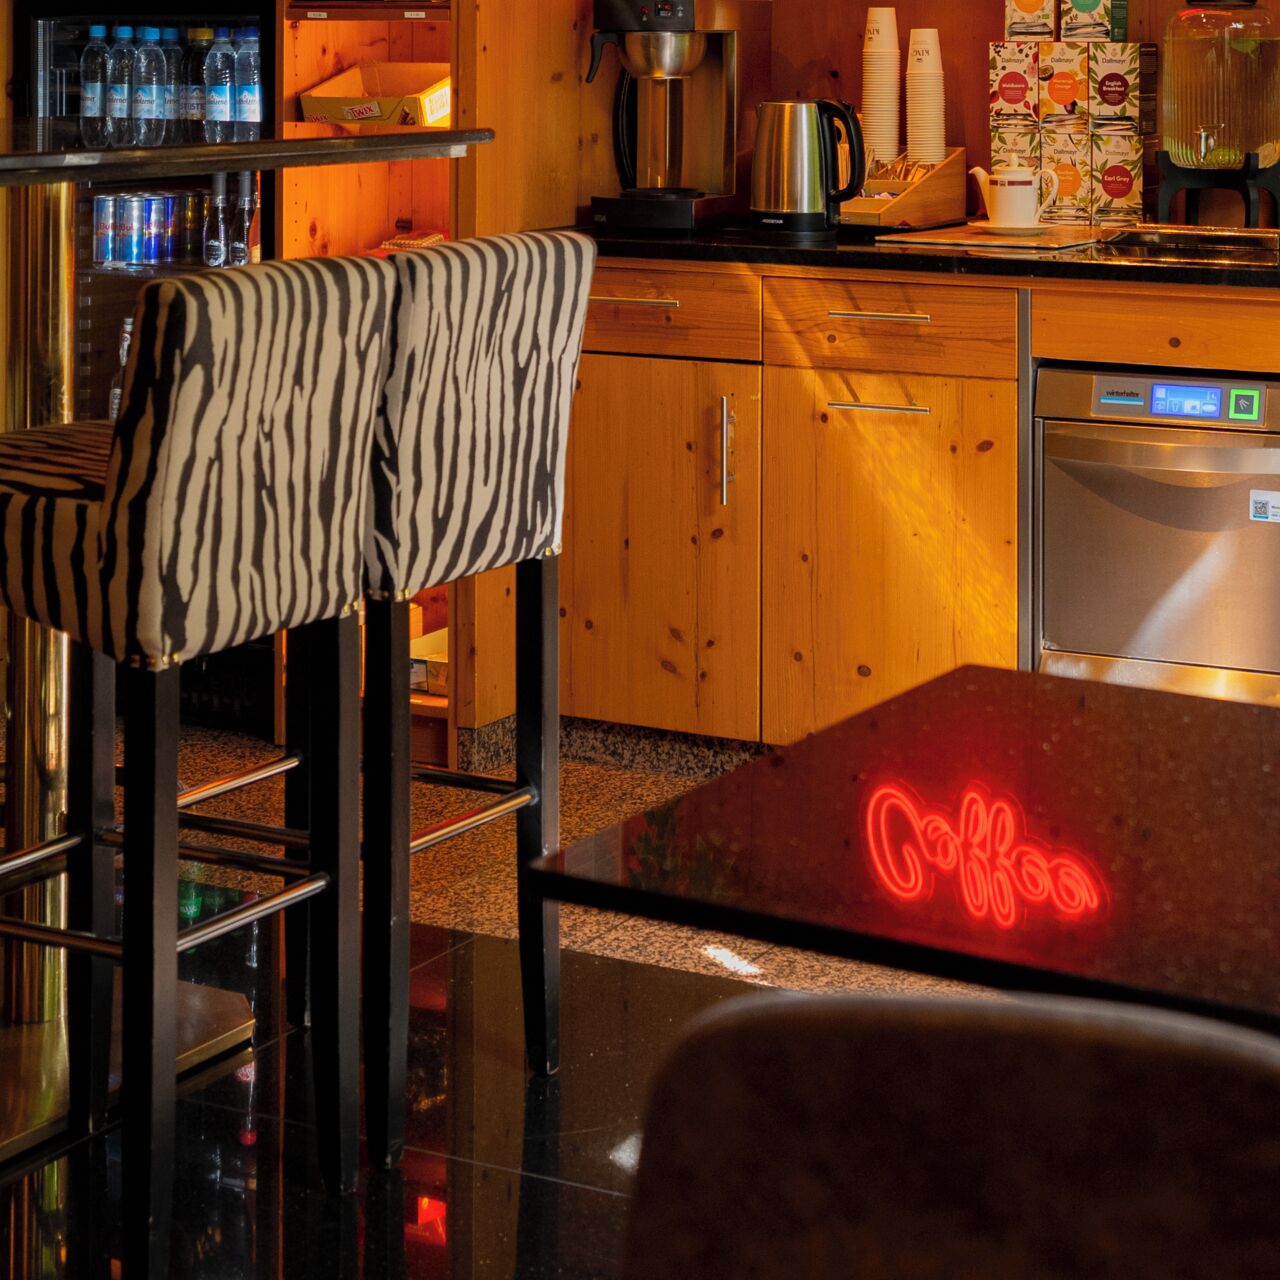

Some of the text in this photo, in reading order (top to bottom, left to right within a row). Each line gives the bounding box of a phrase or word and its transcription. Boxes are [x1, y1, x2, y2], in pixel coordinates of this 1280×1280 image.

[1001, 56, 1025, 65] Dallmayr
[1050, 56, 1075, 64] Dallmayr
[1102, 57, 1127, 65] Dallmayr
